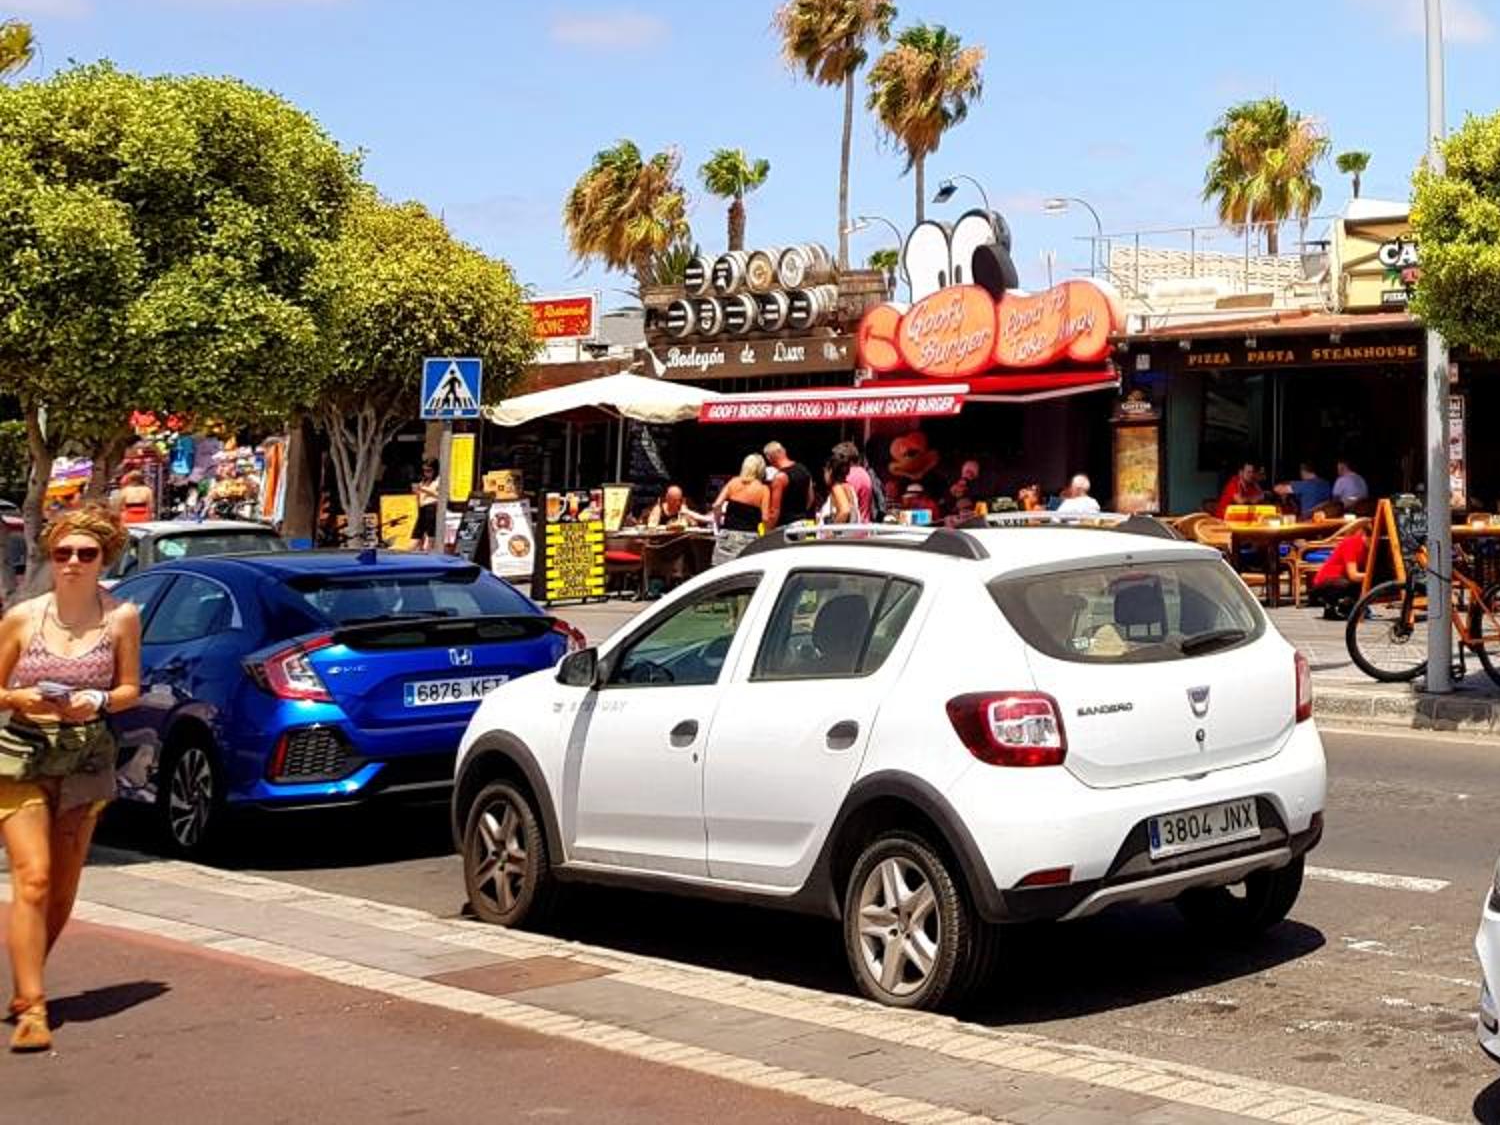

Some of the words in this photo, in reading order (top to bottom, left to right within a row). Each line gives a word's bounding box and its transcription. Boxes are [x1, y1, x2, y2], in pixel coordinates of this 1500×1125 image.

[740, 342, 757, 363] de
[1188, 352, 1232, 365] PIZZA
[1247, 350, 1295, 363] PASTA
[1311, 345, 1418, 360] STEAKHOUSE
[708, 403, 739, 419] GOOFY
[738, 402, 772, 417] BURGER
[773, 402, 797, 417] WITH
[797, 401, 822, 417] FOOD
[823, 401, 836, 415] TO
[837, 400, 860, 415] TAKE
[859, 398, 886, 414] AWAY
[884, 397, 917, 414] GOOFY
[916, 396, 955, 413] BURGER
[417, 682, 463, 702] 6876
[1077, 702, 1133, 717] SANDERO
[1162, 815, 1213, 845] 3804
[1219, 801, 1254, 833] JNX
